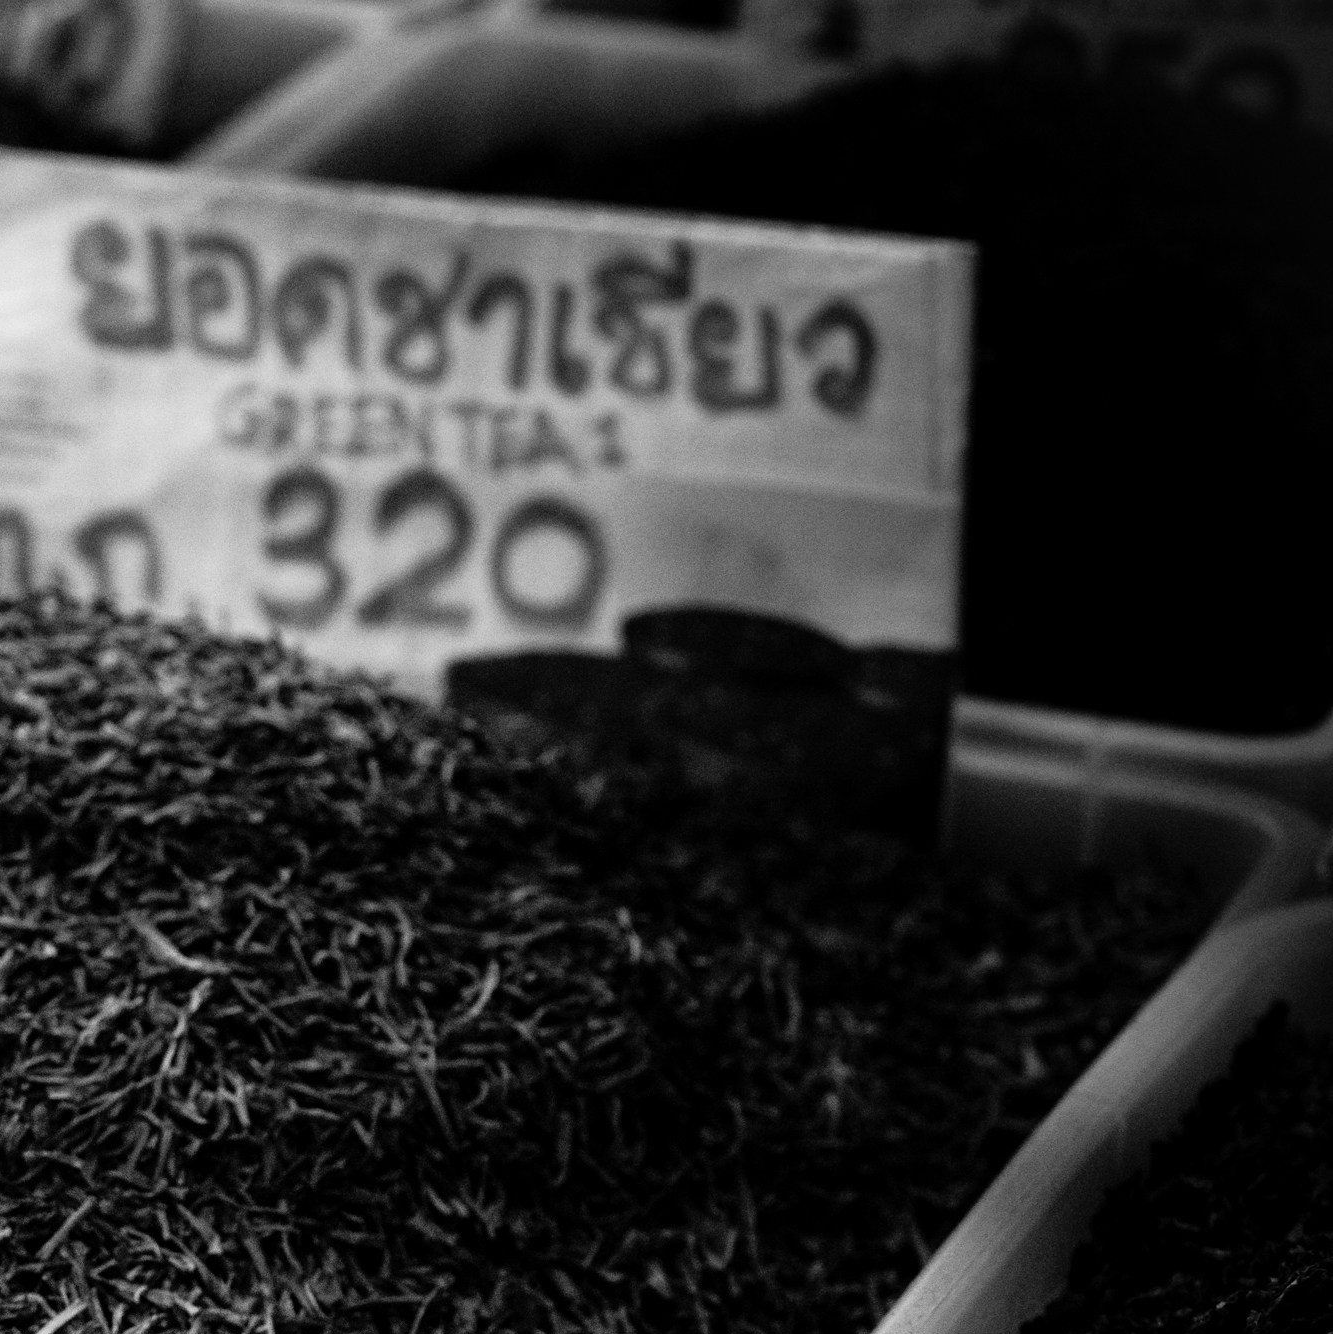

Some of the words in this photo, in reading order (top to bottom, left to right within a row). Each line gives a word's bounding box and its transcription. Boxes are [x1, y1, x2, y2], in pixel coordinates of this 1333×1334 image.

[216, 382, 437, 463] GREEN
[449, 400, 586, 474] TEA
[259, 466, 609, 631] 320
